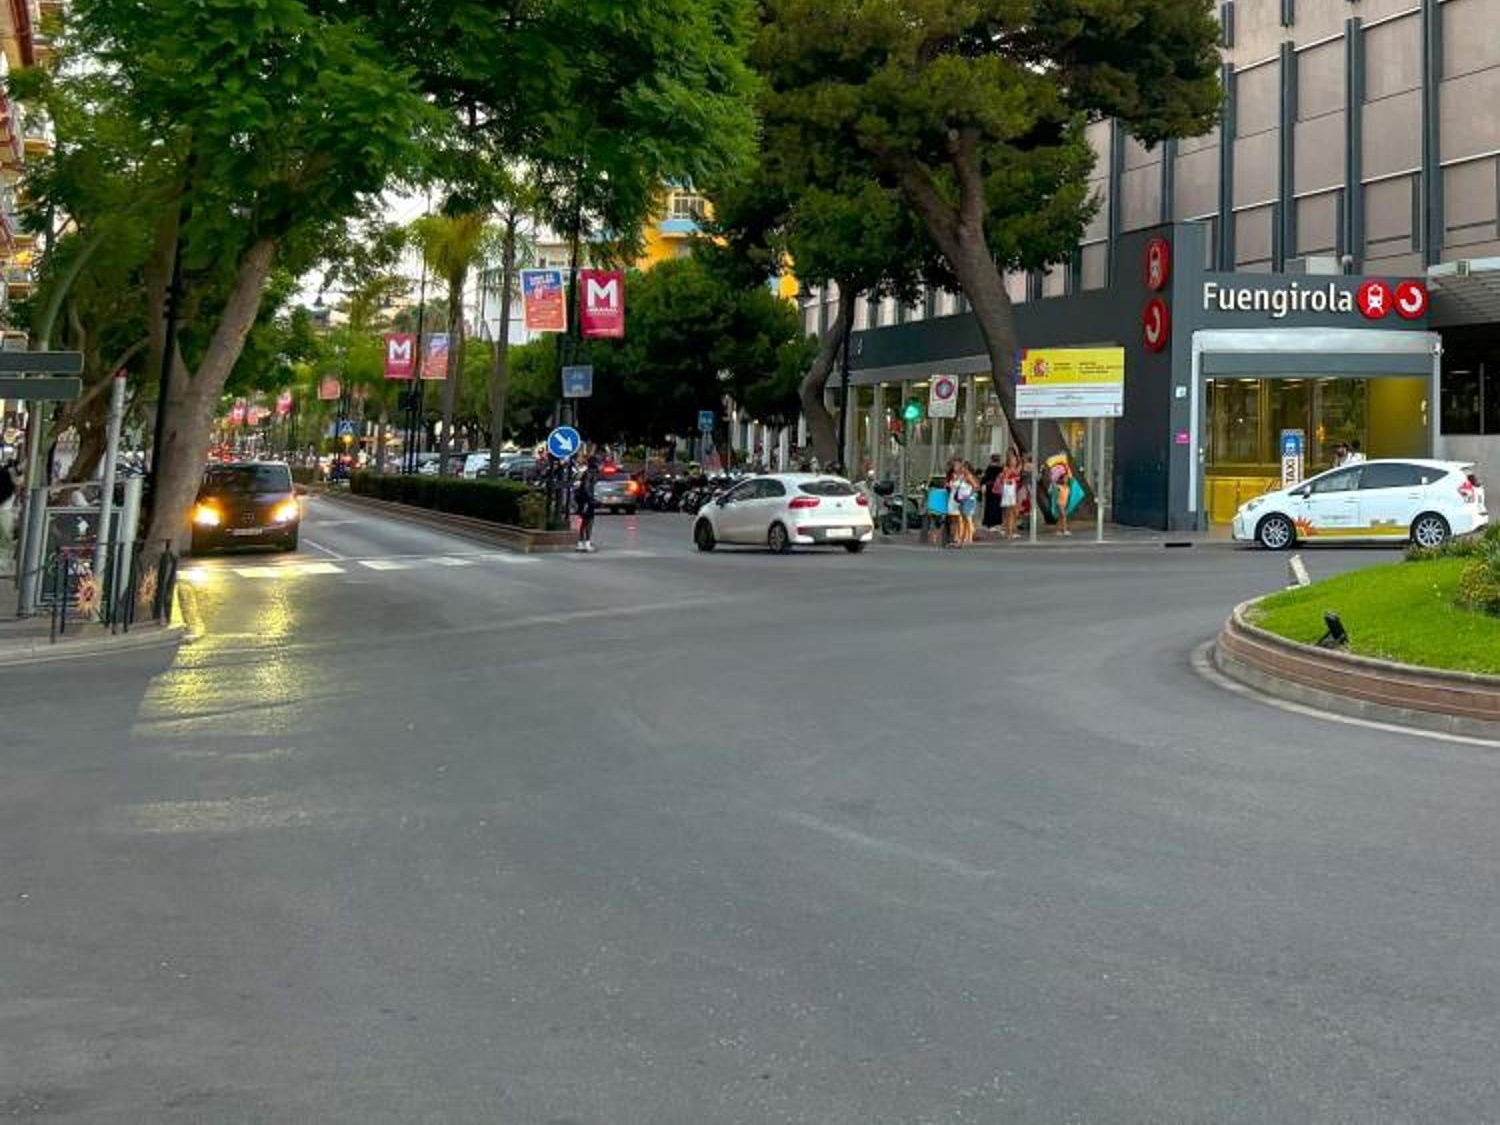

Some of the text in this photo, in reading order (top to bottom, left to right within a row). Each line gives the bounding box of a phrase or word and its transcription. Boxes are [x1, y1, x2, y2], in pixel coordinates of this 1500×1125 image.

[587, 279, 618, 307] M
[1203, 282, 1353, 318] Fuengirola
[389, 339, 411, 360] M
[1286, 458, 1296, 483] TAXI
